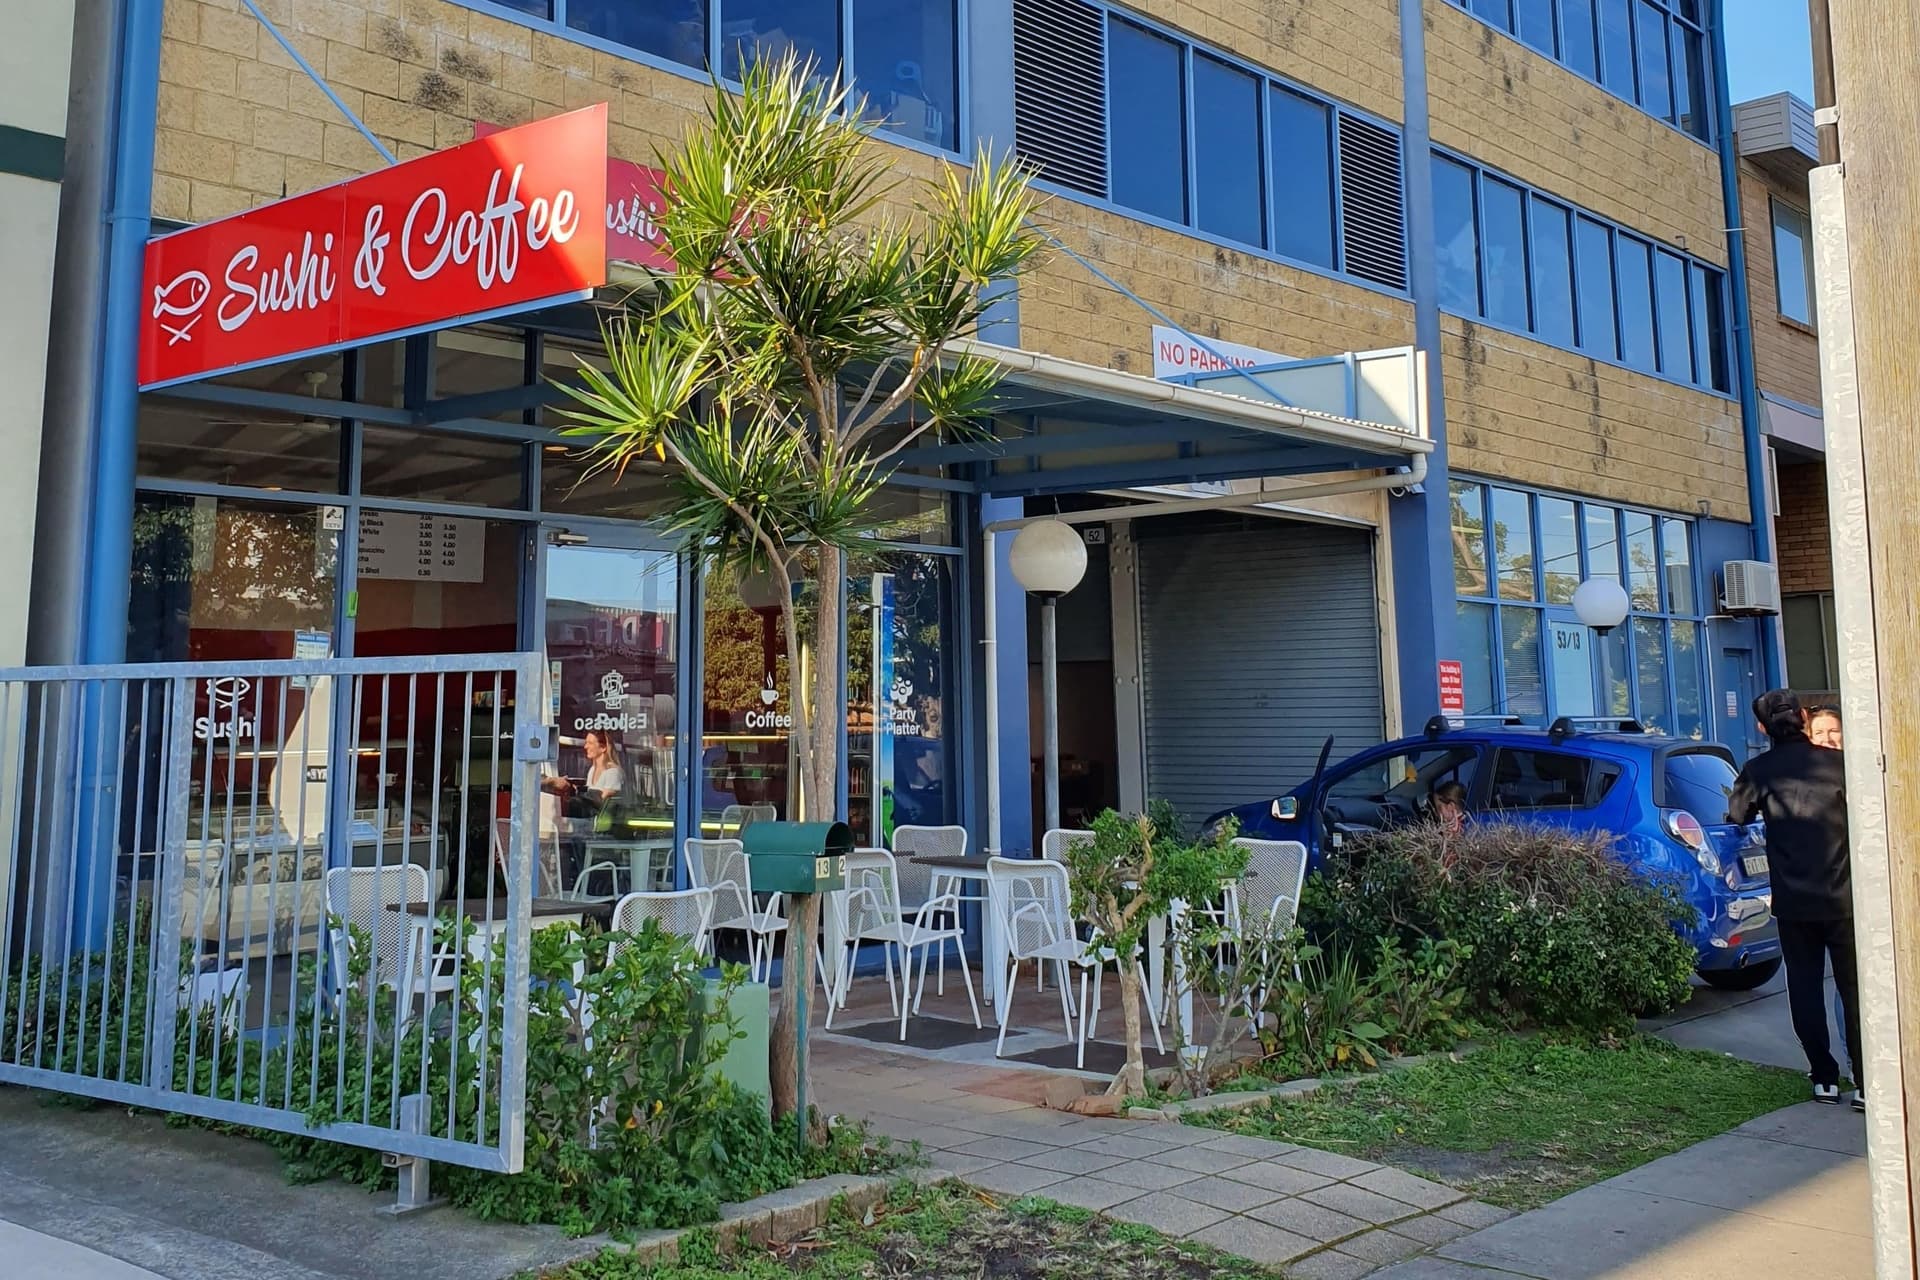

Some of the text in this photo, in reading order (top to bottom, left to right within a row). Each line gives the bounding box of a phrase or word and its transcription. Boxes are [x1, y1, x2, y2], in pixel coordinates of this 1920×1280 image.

[218, 164, 580, 332] Sushi & Coffee
[1160, 341, 1185, 366] NO
[1088, 530, 1101, 542] 52
[1557, 630, 1581, 650] 53/13
[745, 710, 792, 729] Coffee
[890, 707, 917, 722] Party
[886, 722, 921, 735] Platter
[818, 860, 829, 876] 13
